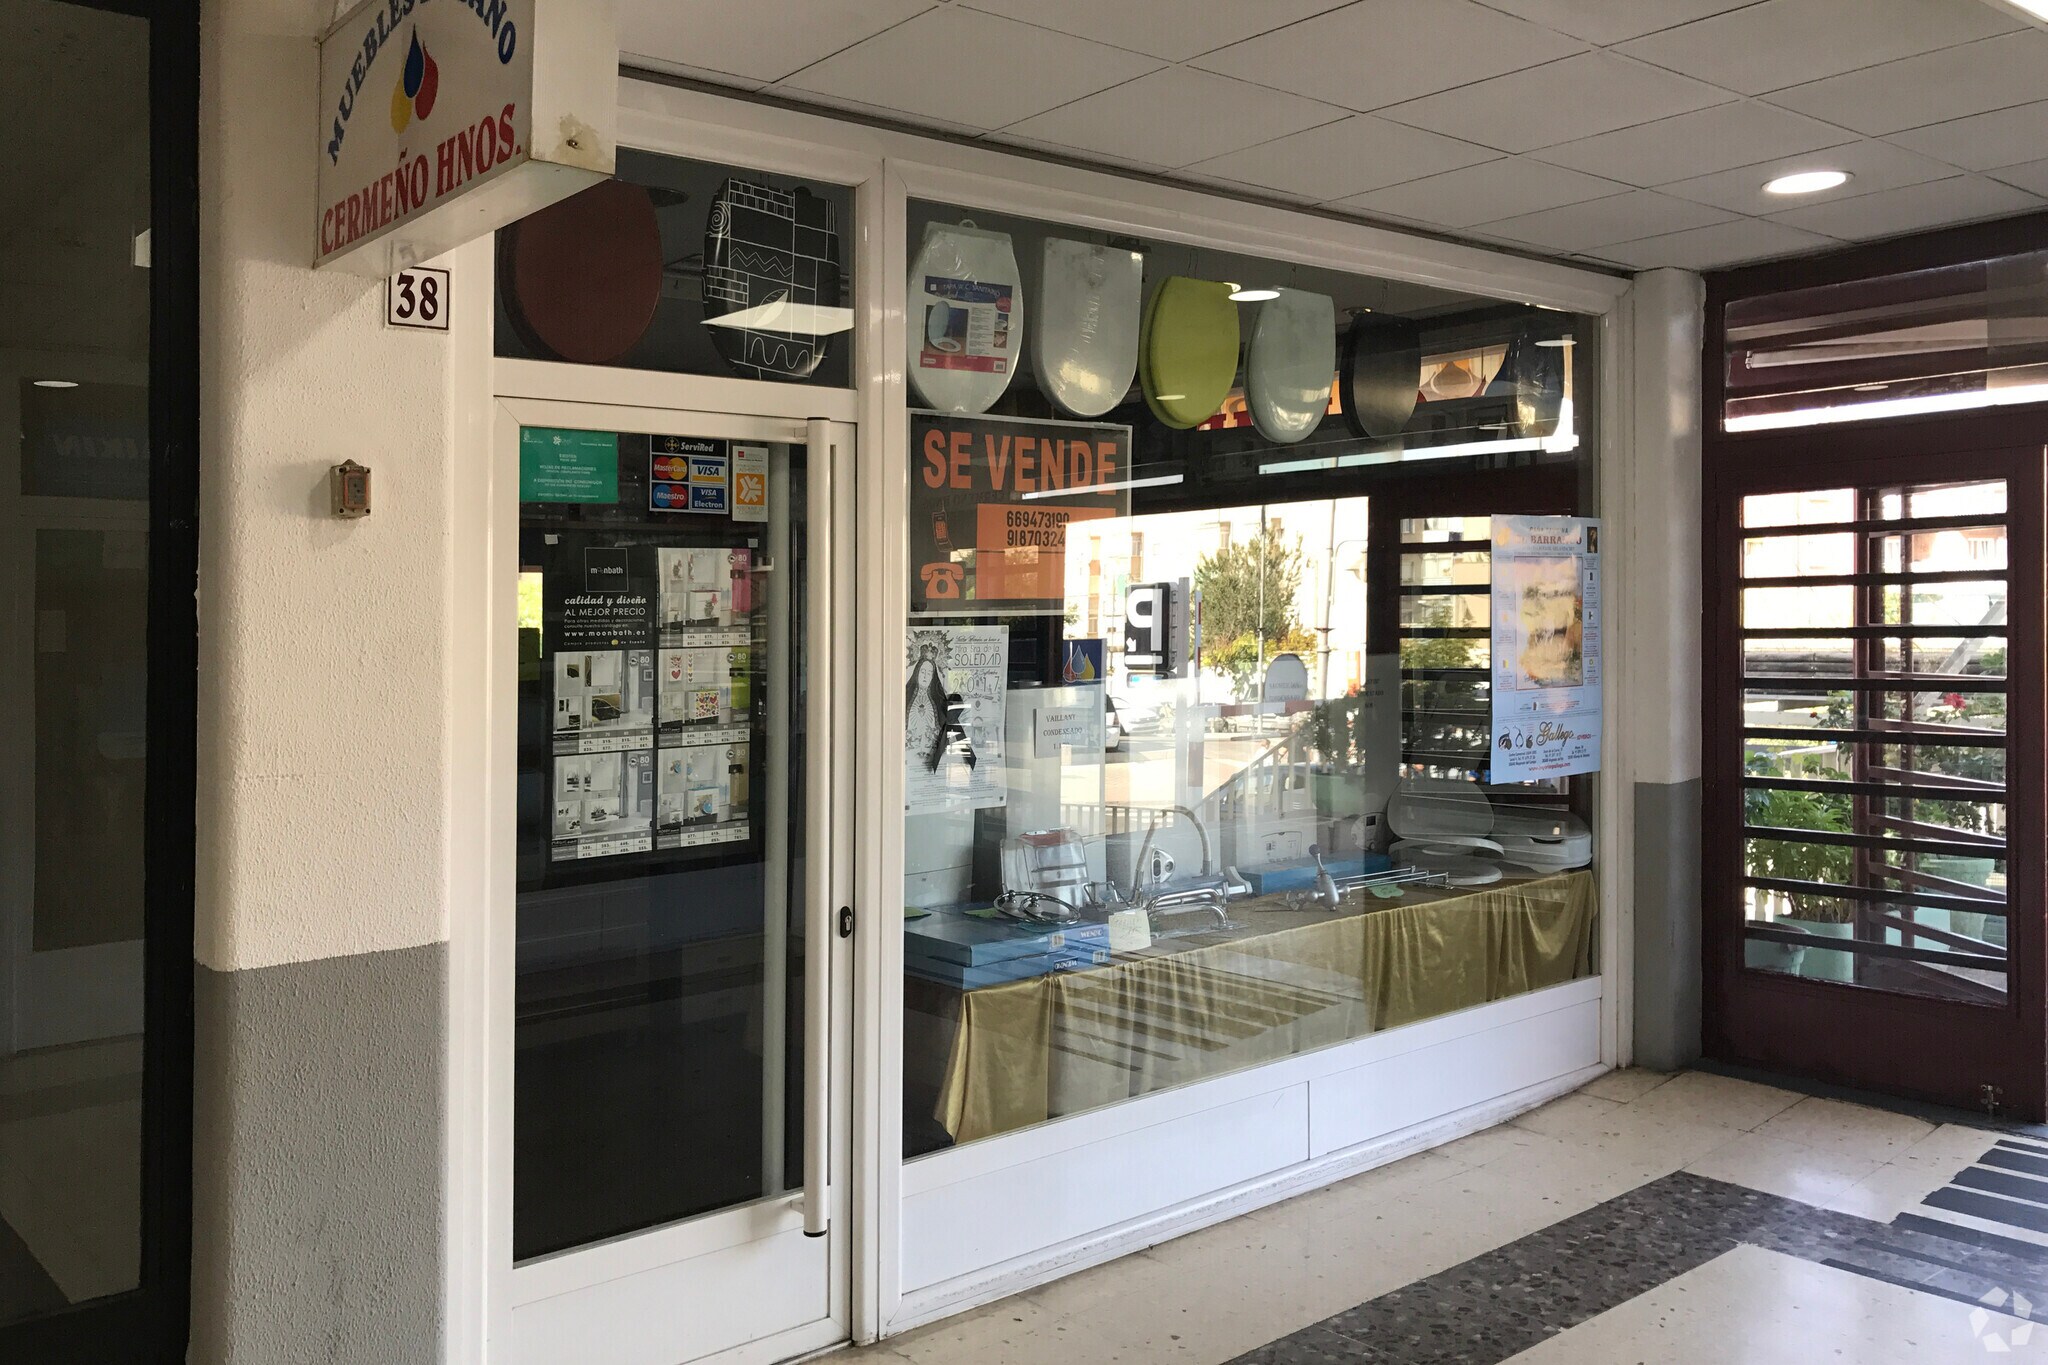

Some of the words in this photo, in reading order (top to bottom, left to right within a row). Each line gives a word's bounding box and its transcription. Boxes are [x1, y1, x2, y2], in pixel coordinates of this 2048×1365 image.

[321, 147, 429, 255] CERMEÑO
[435, 102, 521, 198] HNOS.
[395, 272, 438, 321] 38
[680, 442, 714, 452] ServiRed
[923, 429, 972, 489] SE
[985, 434, 1117, 495] VENDE
[654, 464, 688, 473] MasterCard
[697, 466, 720, 476] VISA
[694, 500, 723, 509] Electron
[564, 595, 603, 605] calidad
[606, 597, 614, 607] y
[616, 595, 647, 604] diseño
[579, 608, 610, 616] MEJOR
[613, 607, 646, 616] PRECIO
[954, 653, 1002, 666] SOLEDAD
[1046, 714, 1076, 722] VAILLANT
